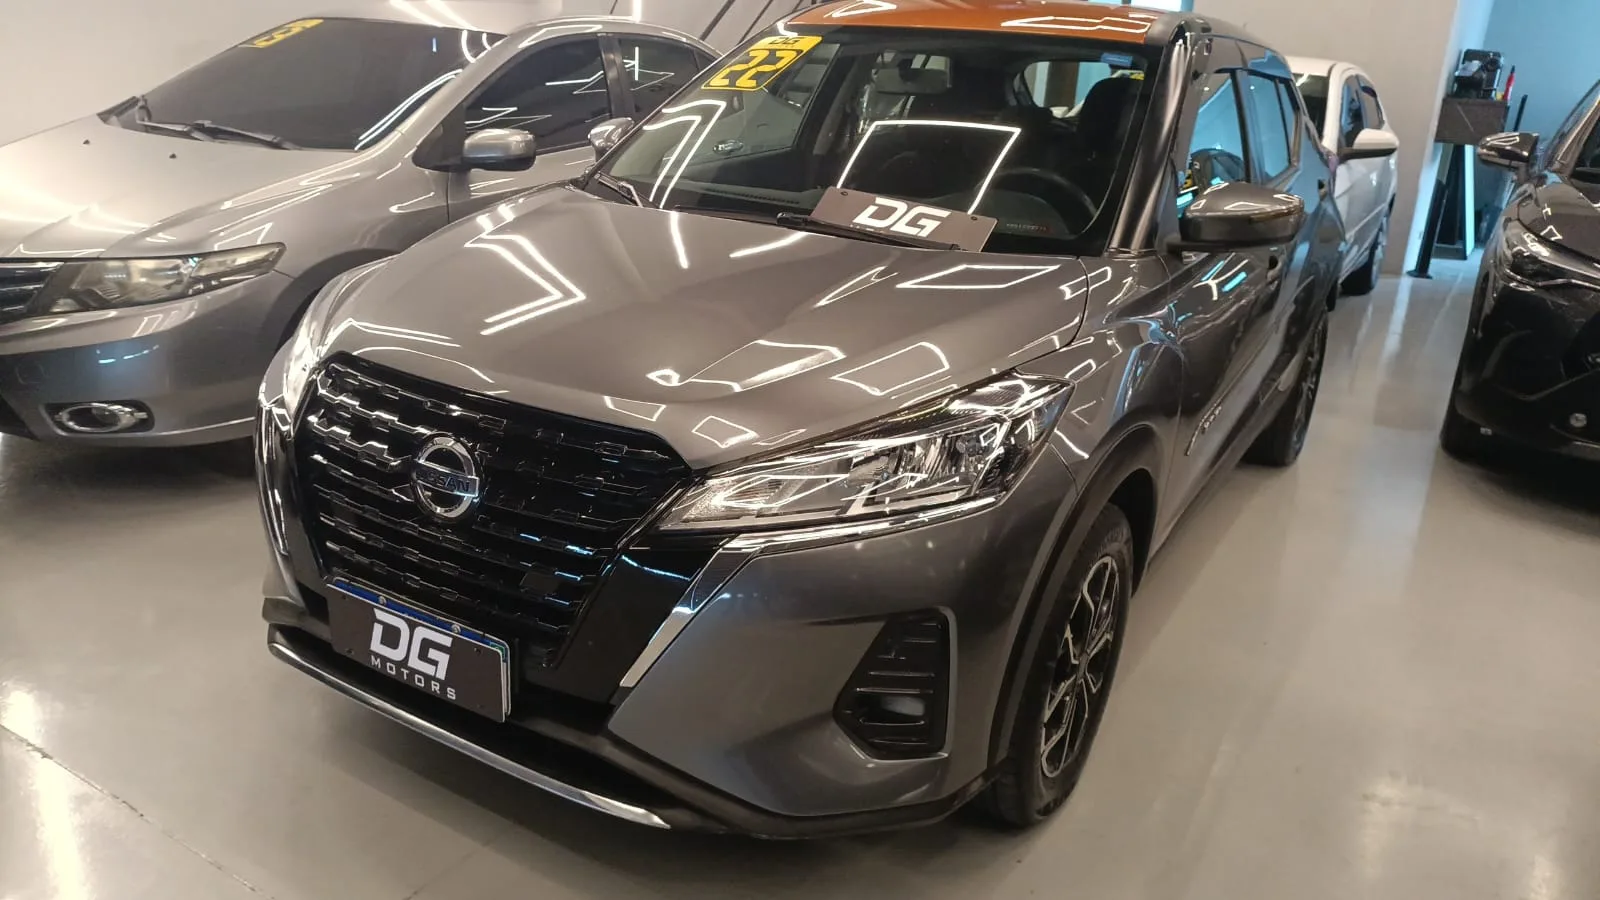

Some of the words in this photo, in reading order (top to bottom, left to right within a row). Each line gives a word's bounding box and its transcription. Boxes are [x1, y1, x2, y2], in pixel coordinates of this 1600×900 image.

[769, 36, 807, 45] DG
[709, 49, 798, 88] 22
[852, 197, 952, 237] DG
[370, 608, 454, 681] DG
[370, 655, 457, 701] MOTORS
